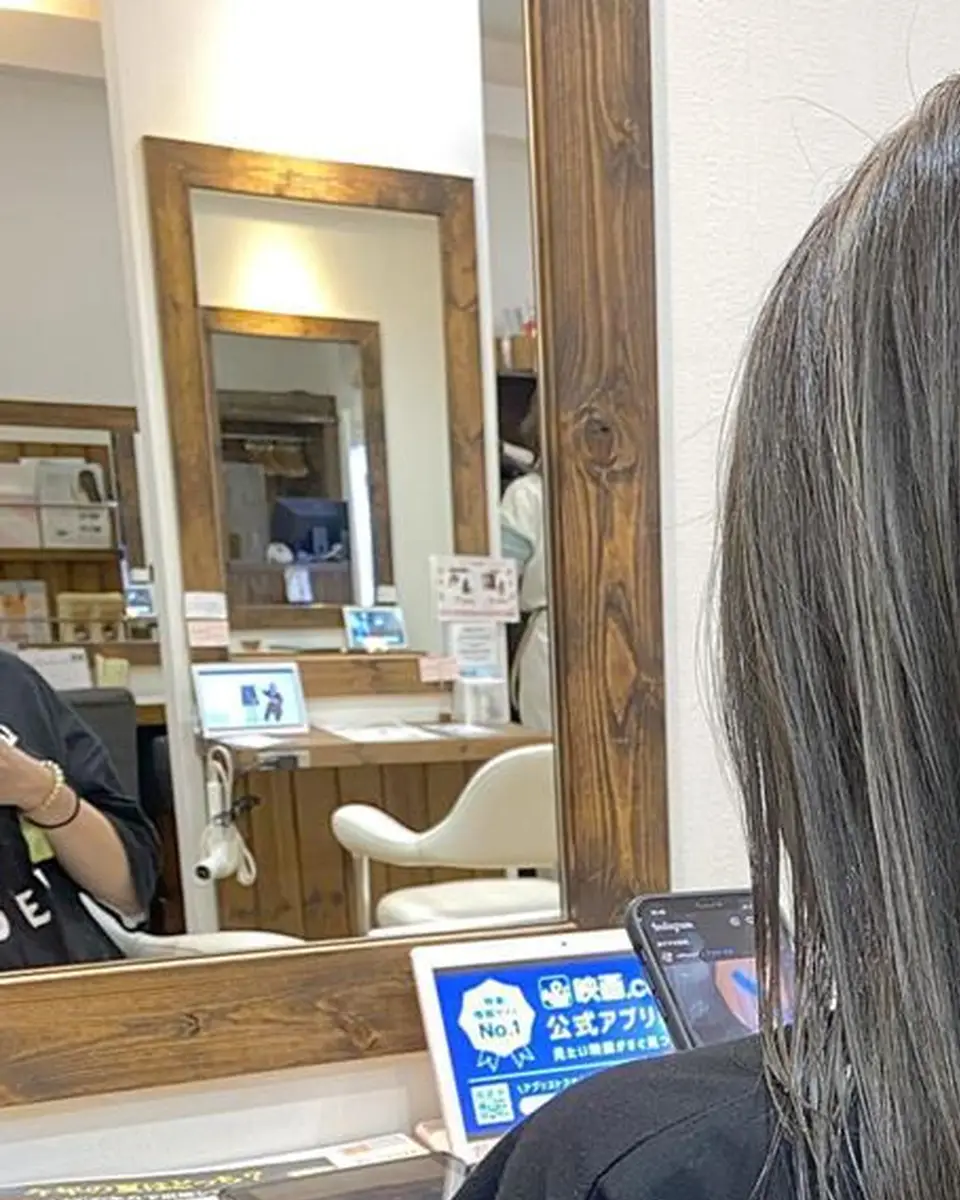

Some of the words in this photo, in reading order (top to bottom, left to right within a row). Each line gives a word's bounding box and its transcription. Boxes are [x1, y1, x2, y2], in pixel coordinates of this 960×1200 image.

[478, 1018, 521, 1040] No.1
[545, 1006, 656, 1042] 公式アプリ
